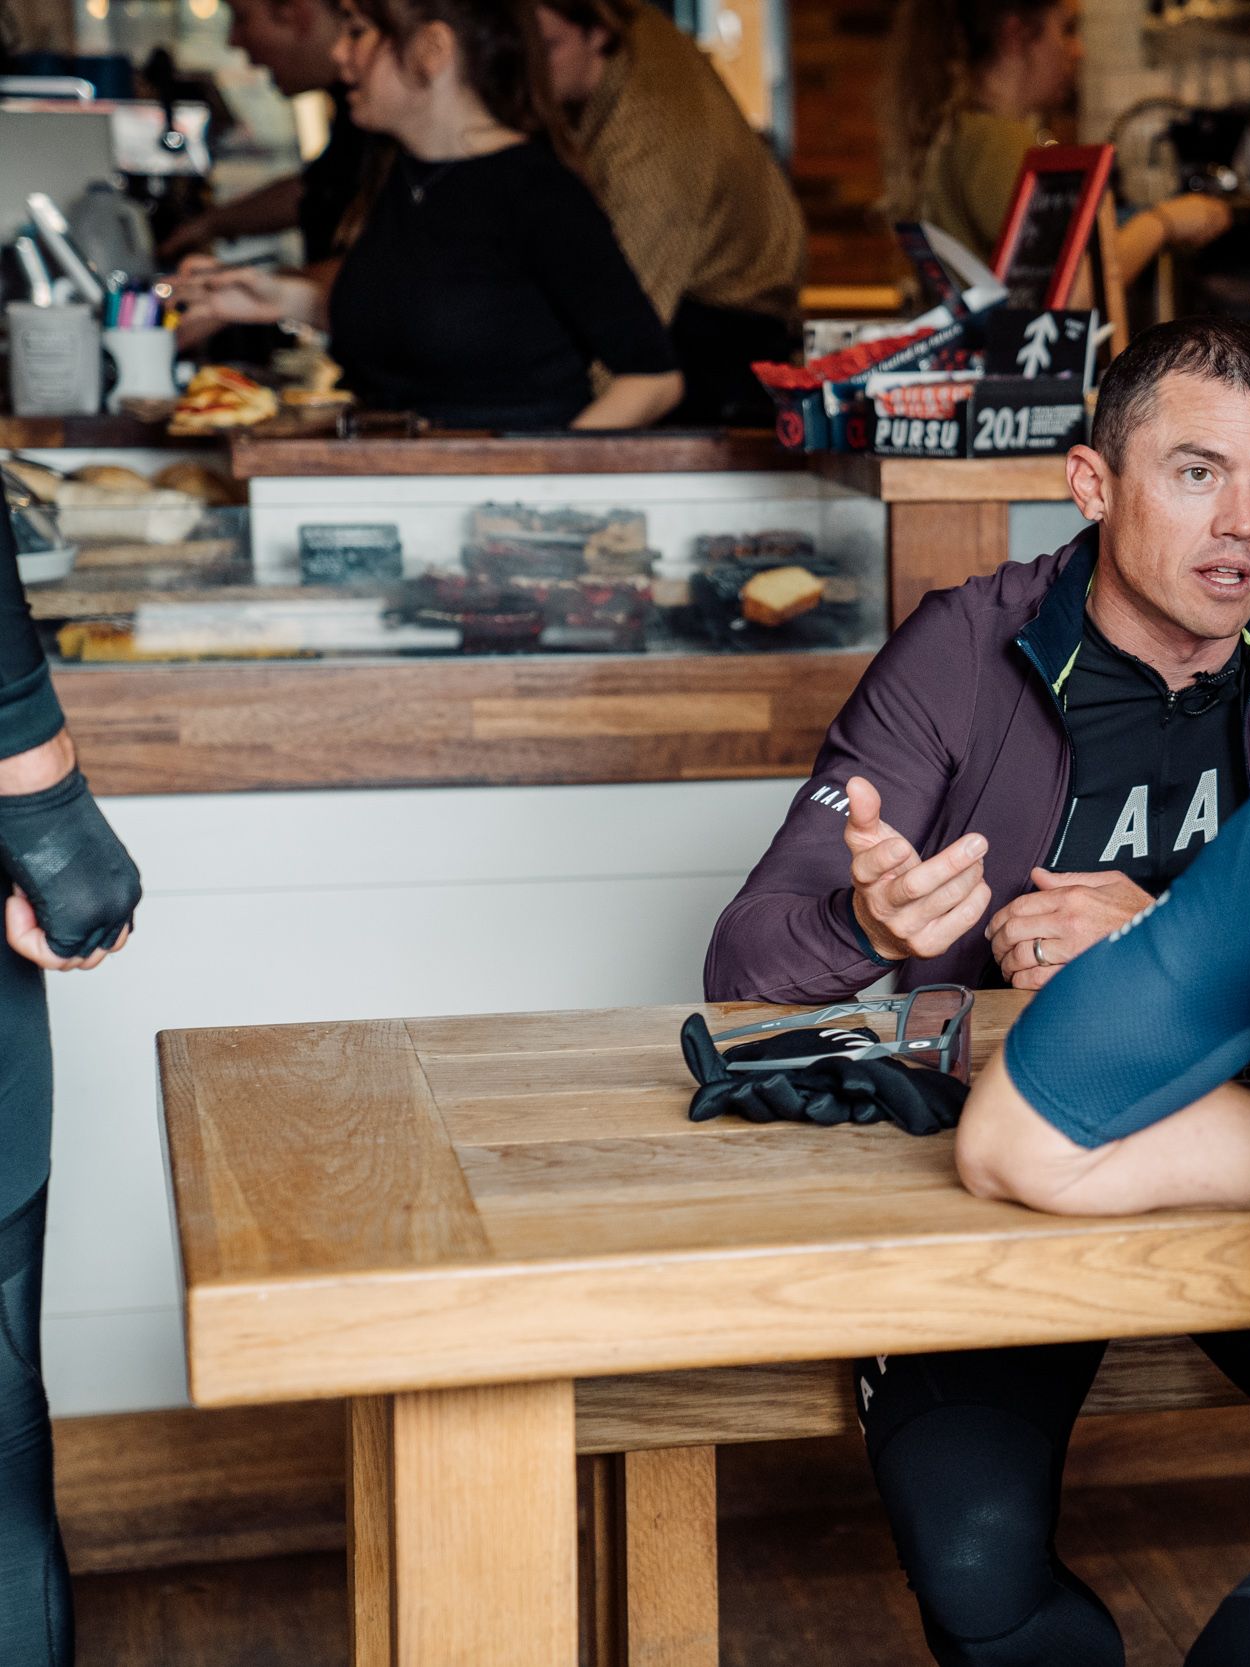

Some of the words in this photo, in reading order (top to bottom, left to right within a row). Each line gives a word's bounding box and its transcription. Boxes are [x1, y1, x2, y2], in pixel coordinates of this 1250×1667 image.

[875, 418, 959, 449] PURSU
[974, 407, 1030, 449] 20.1
[810, 785, 850, 816] MAA
